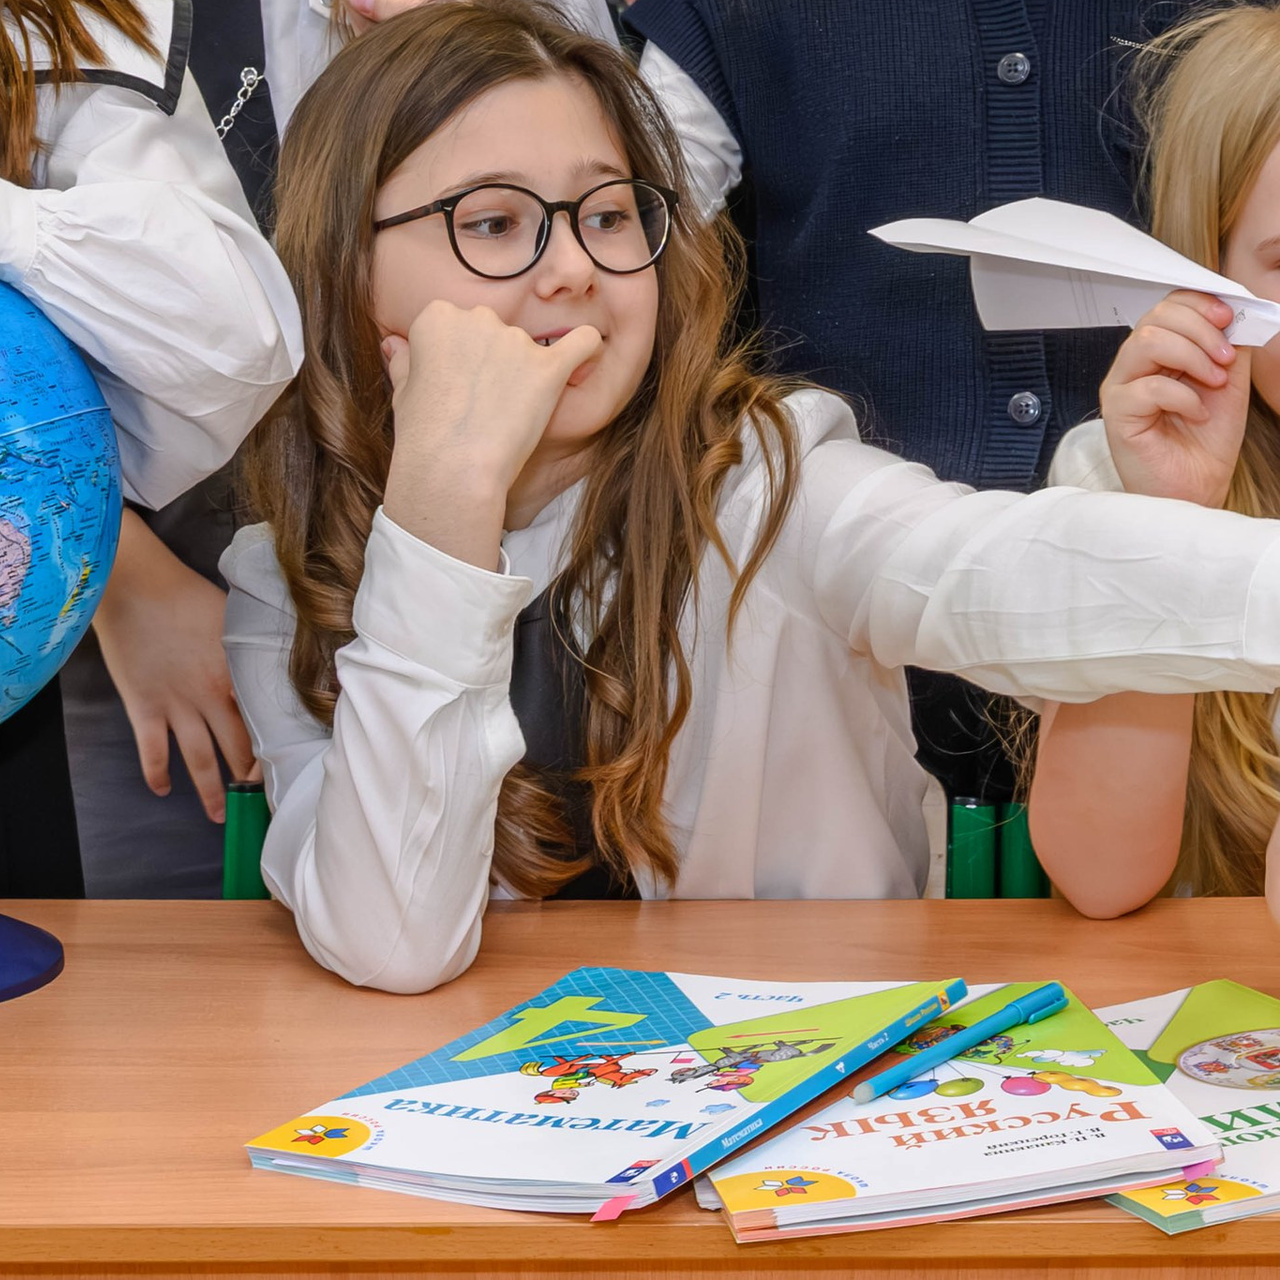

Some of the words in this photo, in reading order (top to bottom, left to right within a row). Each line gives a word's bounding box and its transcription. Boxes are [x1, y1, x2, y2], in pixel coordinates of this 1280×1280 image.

[713, 990, 732, 1000] 2
[447, 994, 648, 1061] 4
[382, 1097, 713, 1139] Математика
[886, 1100, 1151, 1149] Русский
